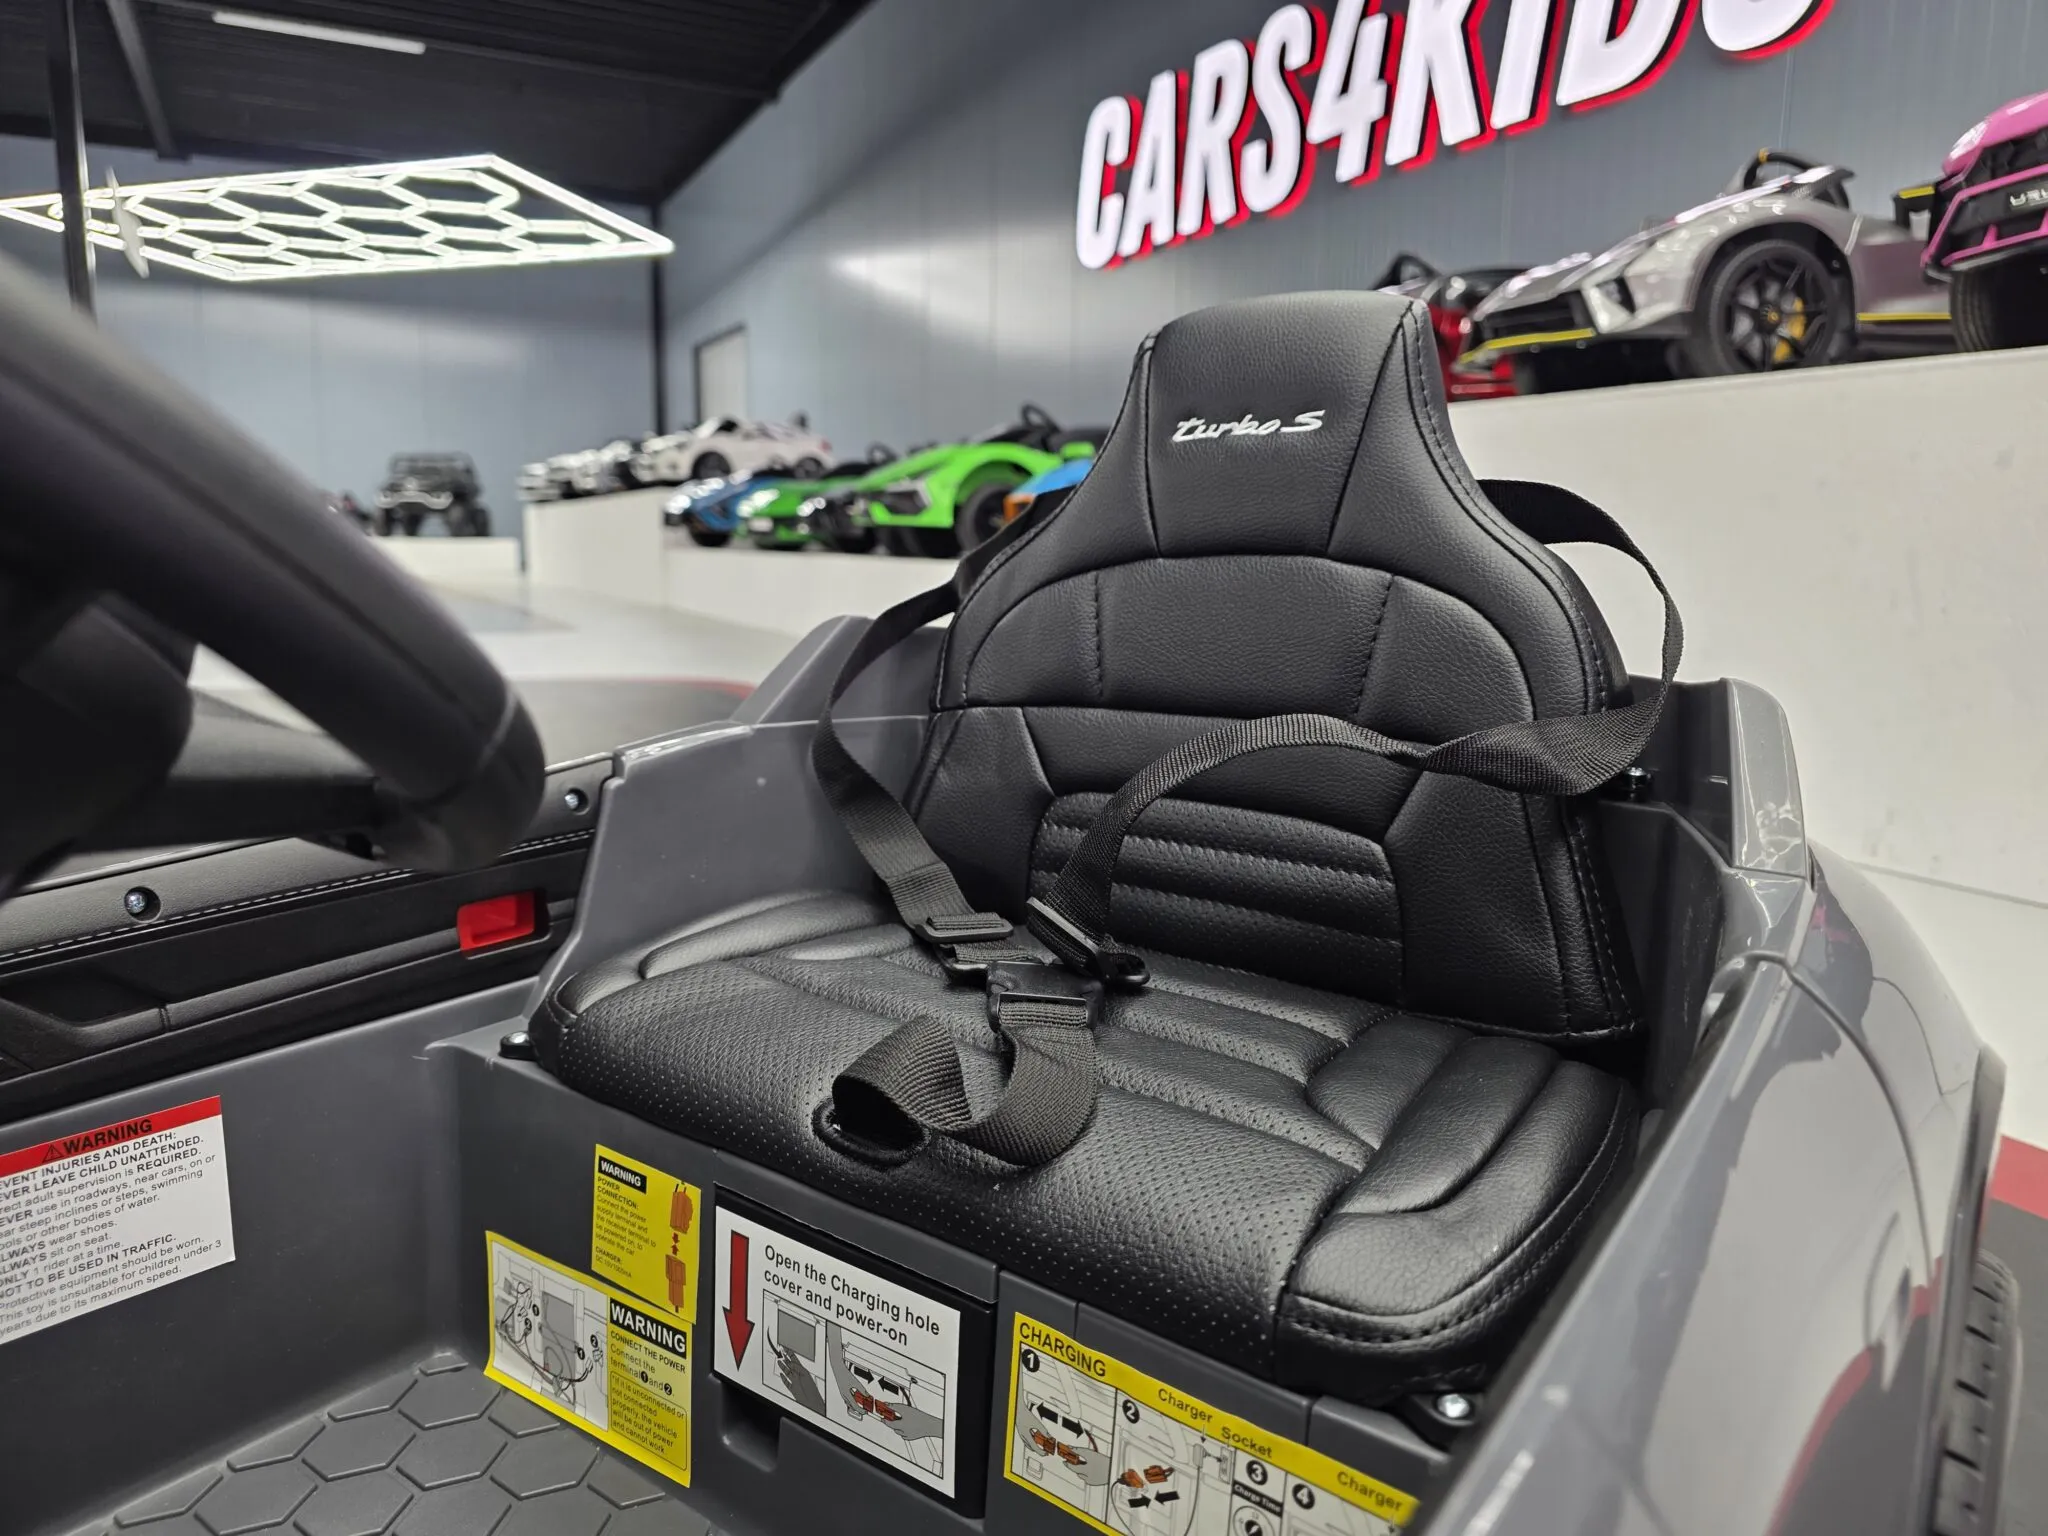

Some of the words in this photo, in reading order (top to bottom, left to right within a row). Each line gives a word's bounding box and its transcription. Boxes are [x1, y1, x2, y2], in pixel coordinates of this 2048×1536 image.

[1076, 0, 1822, 269] CARS4KID
[1172, 413, 1280, 442] turbo
[1281, 409, 1326, 433] S
[42, 1153, 100, 1177] INJURIES
[103, 1145, 130, 1160] AND
[133, 1132, 176, 1151] DEATH:
[63, 1119, 152, 1153] WARNING
[25, 1190, 54, 1207] adult
[57, 1171, 122, 1197] supervision
[125, 1167, 134, 1177] is
[137, 1147, 201, 1173] REQUIRED.
[34, 1172, 77, 1192] LEAVE
[79, 1160, 117, 1178] CHILD
[121, 1135, 204, 1166] UNATTENDED.
[36, 1203, 57, 1215] use
[61, 1199, 71, 1208] in
[134, 1171, 159, 1185] near
[161, 1164, 187, 1177] cars,
[190, 1158, 203, 1168] on
[205, 1154, 216, 1164] or
[600, 1160, 642, 1187] WARNING
[20, 1217, 51, 1232] steep
[55, 1202, 98, 1221] inclines
[101, 1197, 113, 1207] or
[116, 1187, 148, 1203] steps,
[151, 1170, 203, 1191] swimming
[26, 1232, 37, 1242] or
[41, 1221, 71, 1237] other
[74, 1210, 111, 1226] bodies
[114, 1203, 125, 1214] of
[127, 1194, 160, 1209] water.
[50, 1231, 77, 1246] wear
[80, 1219, 117, 1236] shoes.
[50, 1246, 64, 1258] sit
[67, 1241, 80, 1252] on
[84, 1233, 112, 1247] seat.
[27, 1278, 44, 1290] TO
[48, 1269, 65, 1282] BE
[69, 1257, 103, 1276] USED
[107, 1251, 119, 1263] IN
[121, 1234, 177, 1257] TRAFFIC.
[27, 1303, 44, 1315] toy
[48, 1298, 57, 1307] is
[61, 1277, 119, 1302] unsuitable
[121, 1270, 137, 1281] for
[139, 1255, 181, 1275] children
[184, 1243, 212, 1260] under
[215, 1239, 222, 1249] 3
[34, 1267, 39, 1276] 1
[44, 1256, 71, 1271] rider
[73, 1252, 84, 1263] at
[87, 1249, 94, 1258] a
[96, 1241, 123, 1255] time.
[60, 1264, 119, 1290] equipment
[122, 1251, 157, 1269] should
[160, 1246, 173, 1257] be
[176, 1237, 204, 1250] worn.
[35, 1309, 57, 1324] due
[60, 1303, 71, 1315] to
[74, 1298, 87, 1310] its
[91, 1279, 143, 1303] maximum
[146, 1265, 182, 1284] speed.
[764, 1269, 802, 1297] cover
[805, 1289, 831, 1311] and
[836, 1303, 907, 1346] power-on
[765, 1244, 800, 1274] Open
[804, 1262, 826, 1285] the
[831, 1275, 900, 1321] Charging
[905, 1306, 940, 1336] hole
[611, 1303, 686, 1353] WARNING
[1020, 1322, 1106, 1377] CHARGING
[610, 1331, 642, 1352] CONNECT
[643, 1346, 657, 1360] THE
[659, 1354, 686, 1374] POWER
[610, 1343, 641, 1367] Connect
[643, 1359, 655, 1374] the
[632, 1387, 676, 1415] unconnected
[676, 1411, 685, 1420] or
[642, 1413, 652, 1424] the
[1157, 1388, 1213, 1423] Charger
[1221, 1425, 1272, 1458] Socket
[1336, 1471, 1403, 1511] Charger
